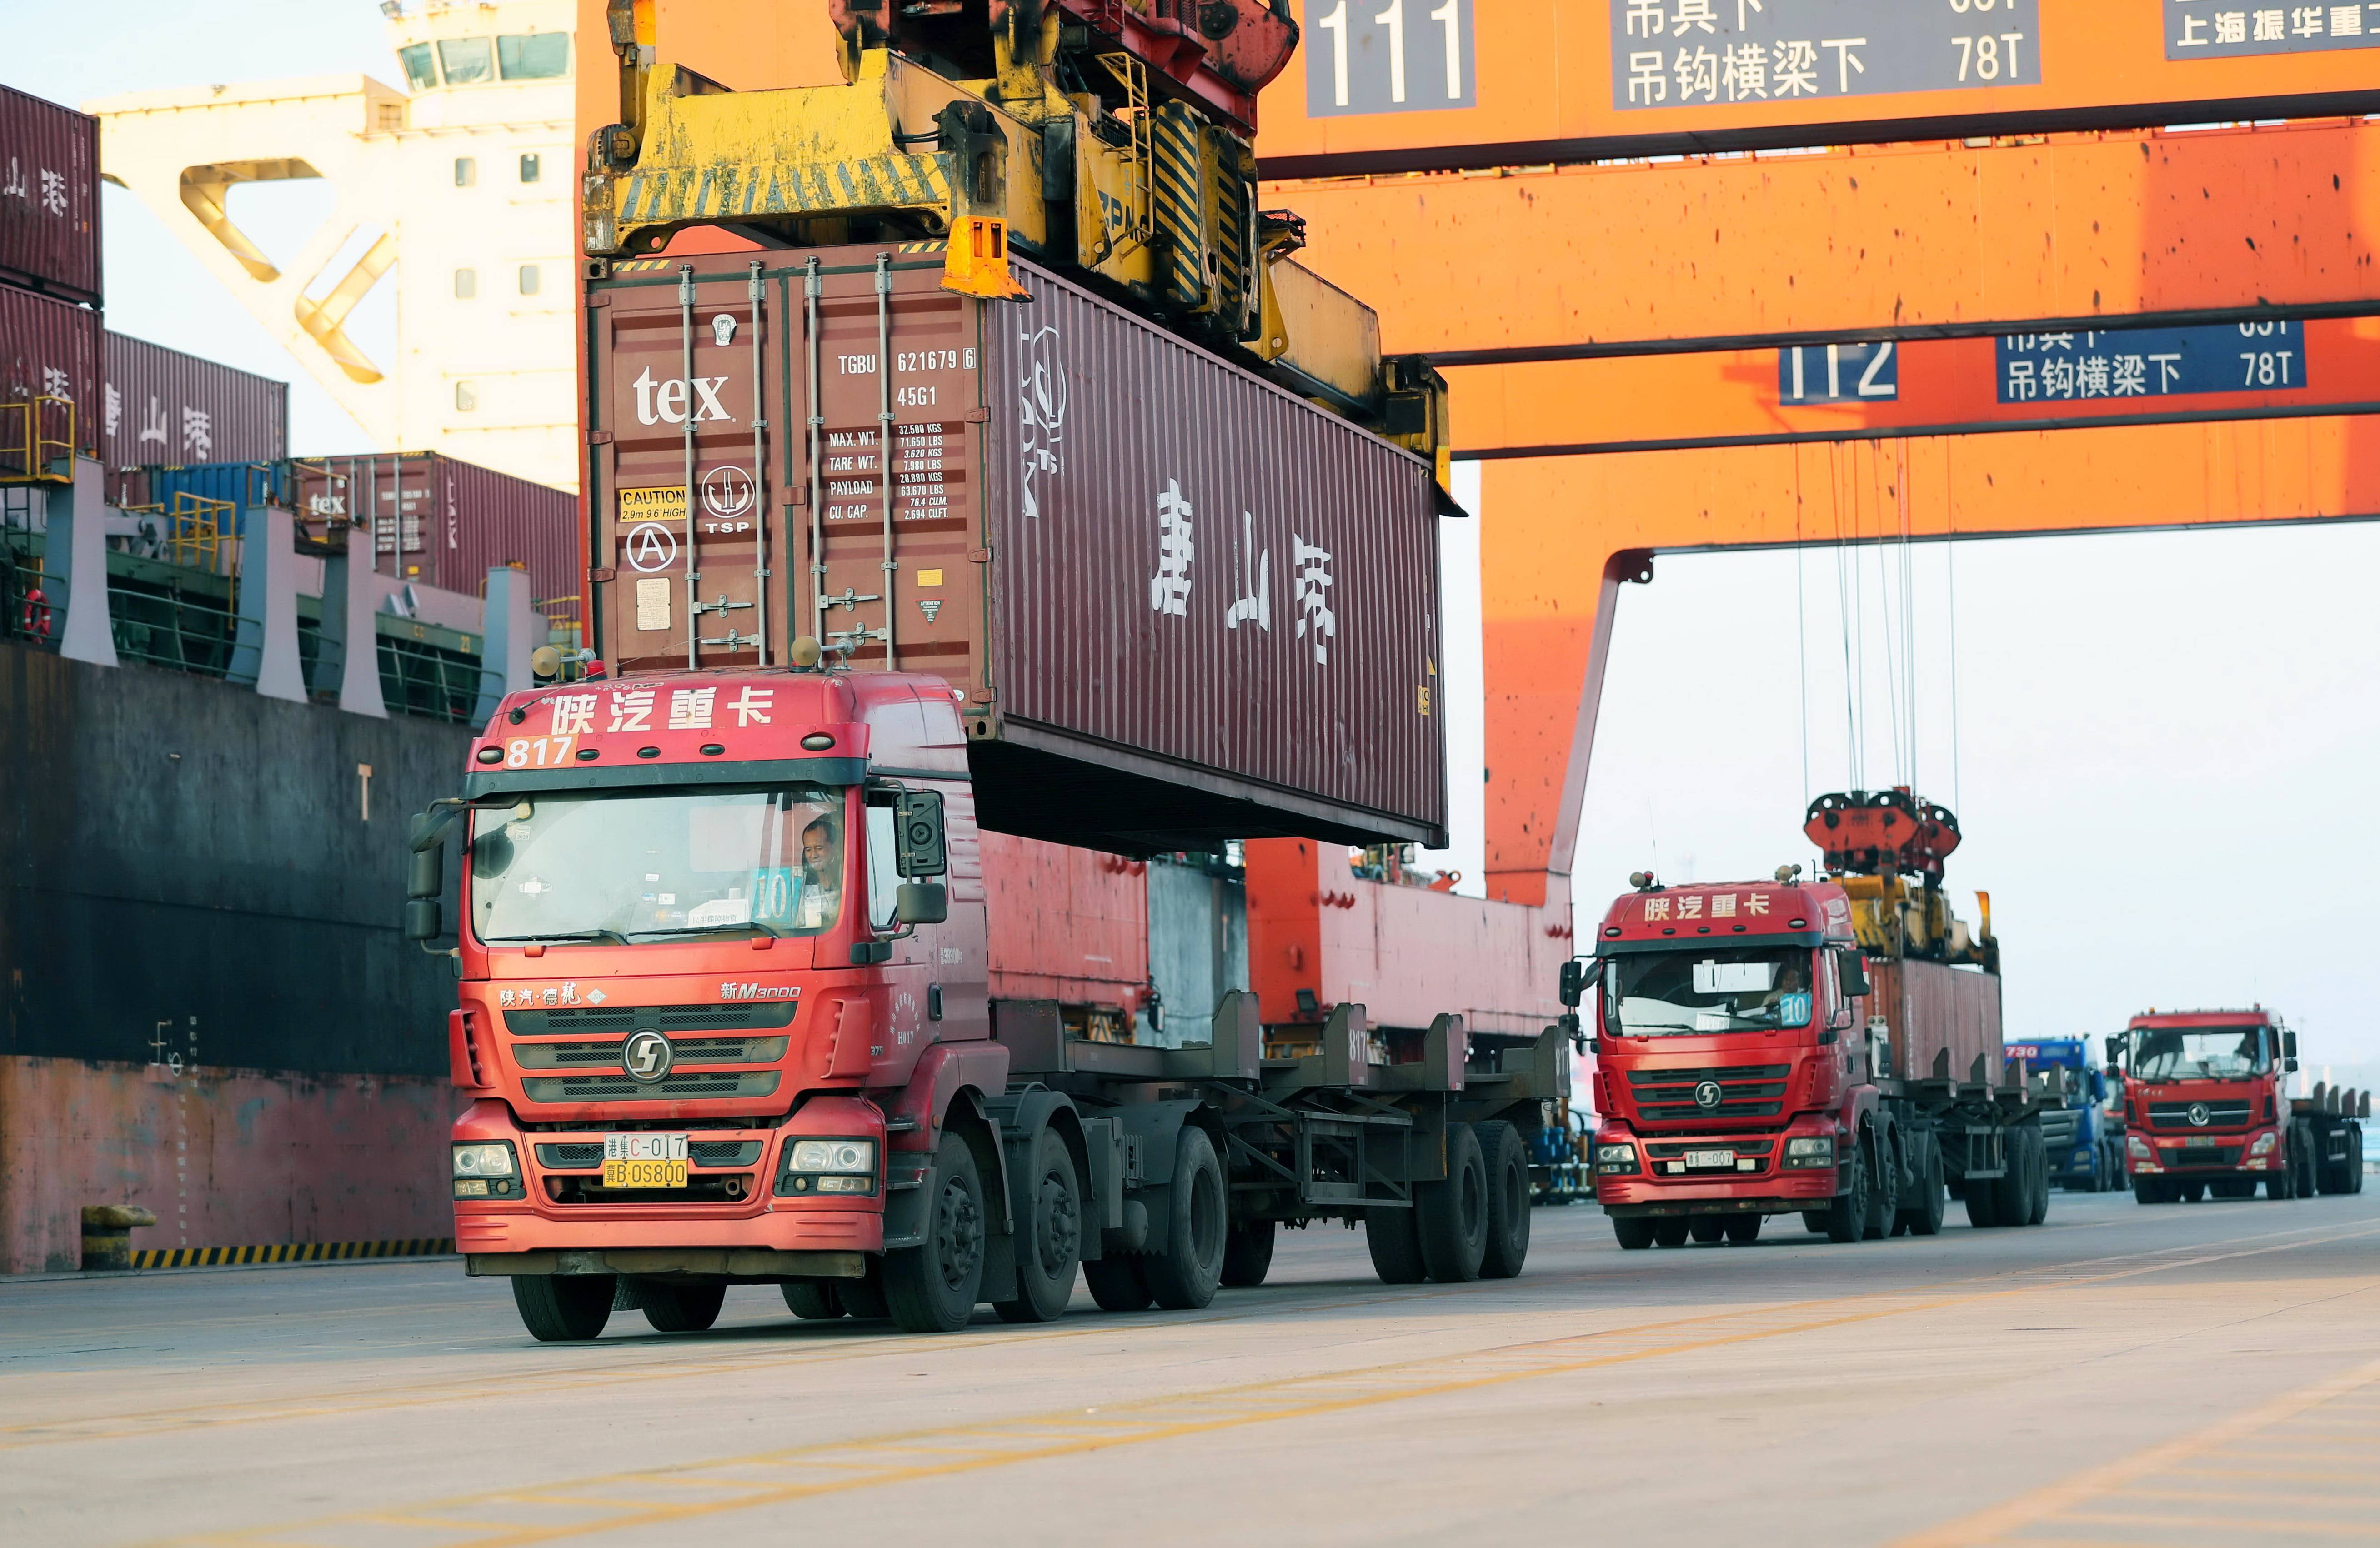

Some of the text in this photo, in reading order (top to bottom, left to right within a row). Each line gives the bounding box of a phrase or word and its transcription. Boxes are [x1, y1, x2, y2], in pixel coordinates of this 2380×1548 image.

[1319, 0, 1461, 106] 111
[1628, 32, 2023, 105] 吊钩横梁下 78T
[838, 349, 975, 374] TGBU 621679 6
[1792, 341, 1895, 399] 112
[2009, 351, 2293, 401] 吊钩横梁下 78T
[632, 366, 732, 426] tex
[897, 386, 936, 406] 45G1
[927, 423, 942, 433] KGS
[829, 431, 878, 447] MAX. WT.
[928, 436, 943, 446] LBS
[927, 448, 942, 457] KGS
[830, 456, 877, 471] TARE WT.
[927, 460, 942, 470] LBS
[928, 472, 943, 482] KGS
[830, 480, 873, 496] PAYLOAD
[929, 484, 944, 495] LBS
[623, 490, 685, 506] CAUTION
[910, 498, 926, 507] 76.4
[663, 508, 686, 517] HIGH
[829, 504, 868, 519] CU. CAP.
[705, 521, 750, 534] TSP
[637, 529, 666, 562] A
[551, 686, 775, 735] 陕汽重卡
[507, 736, 573, 768] 817
[755, 874, 787, 918] 10
[1644, 892, 1769, 922] 陕汽重卡
[1787, 996, 1806, 1023] 10
[1349, 1028, 1366, 1062] 817
